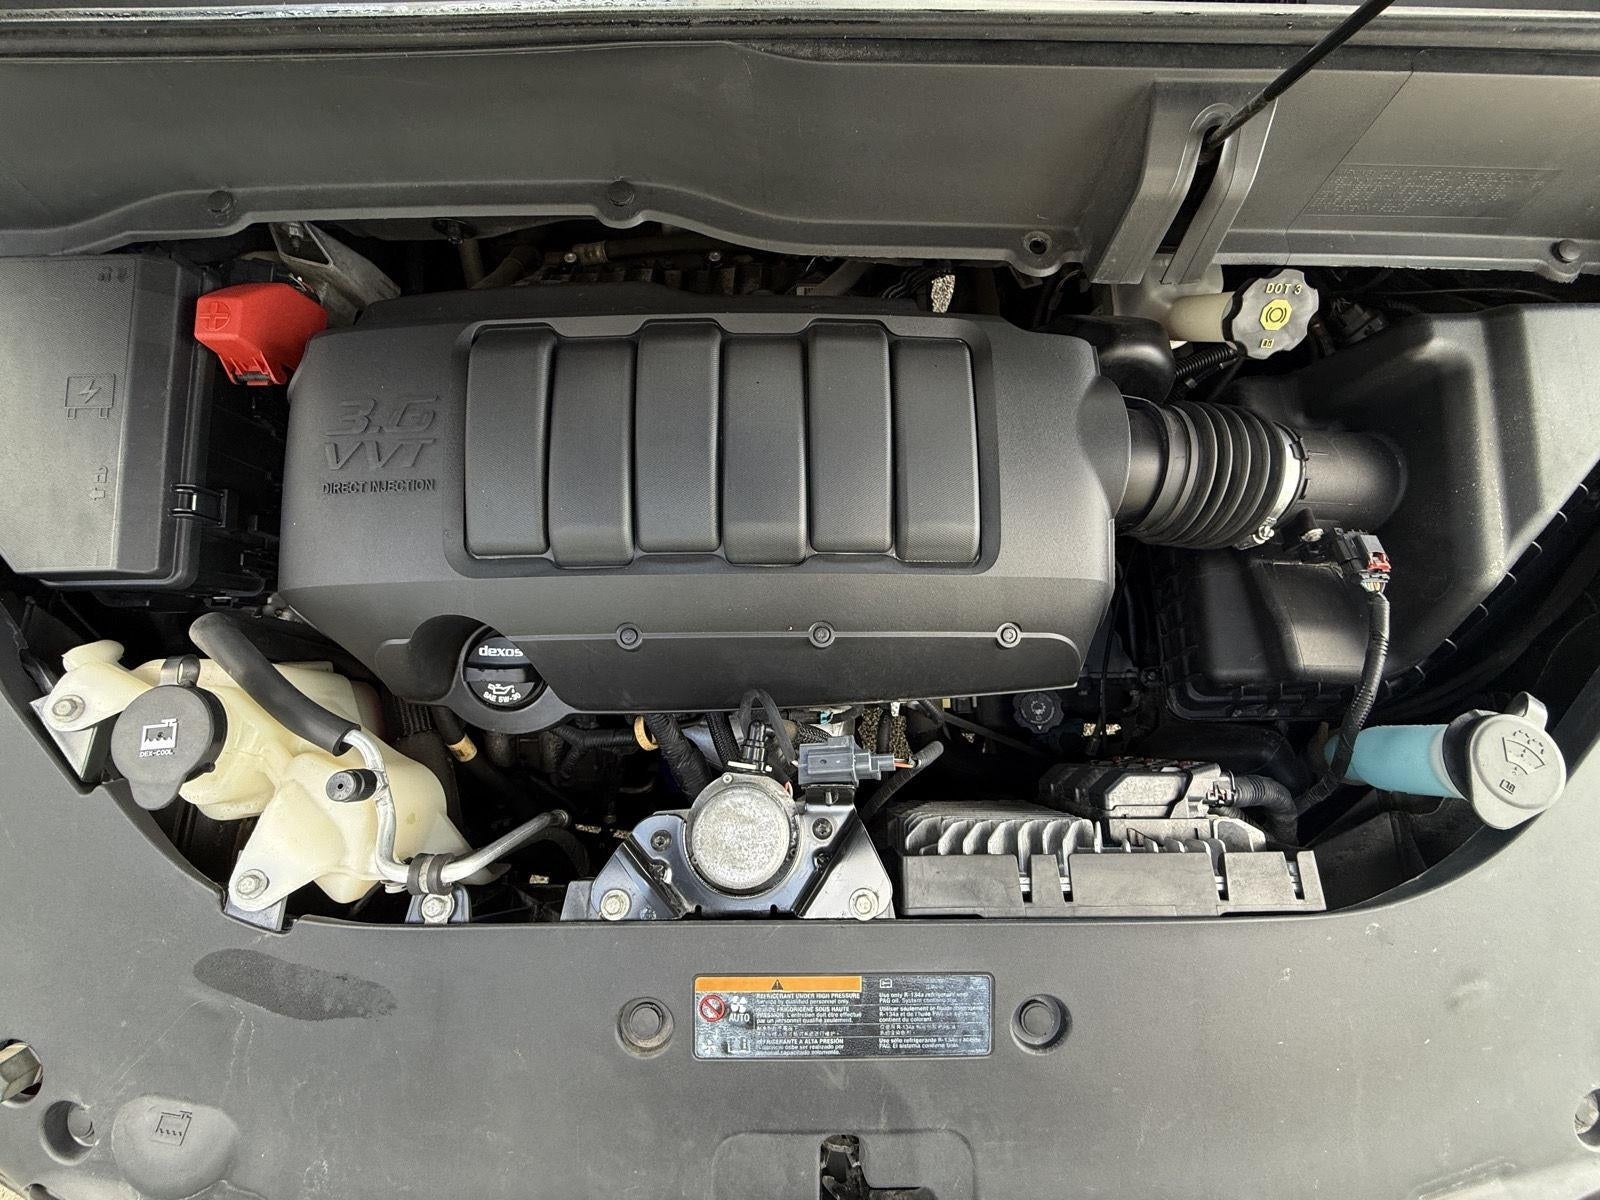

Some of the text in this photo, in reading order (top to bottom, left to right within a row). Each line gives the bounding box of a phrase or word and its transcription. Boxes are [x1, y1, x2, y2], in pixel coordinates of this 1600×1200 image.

[1265, 282, 1302, 295] DOT 3
[323, 439, 437, 471] VVT
[322, 479, 435, 495] DIRECT INJECTION
[478, 645, 524, 657] dexos
[483, 691, 498, 702] SAE
[139, 749, 174, 758] DEX-COOL
[729, 1013, 750, 1022] AUTO
